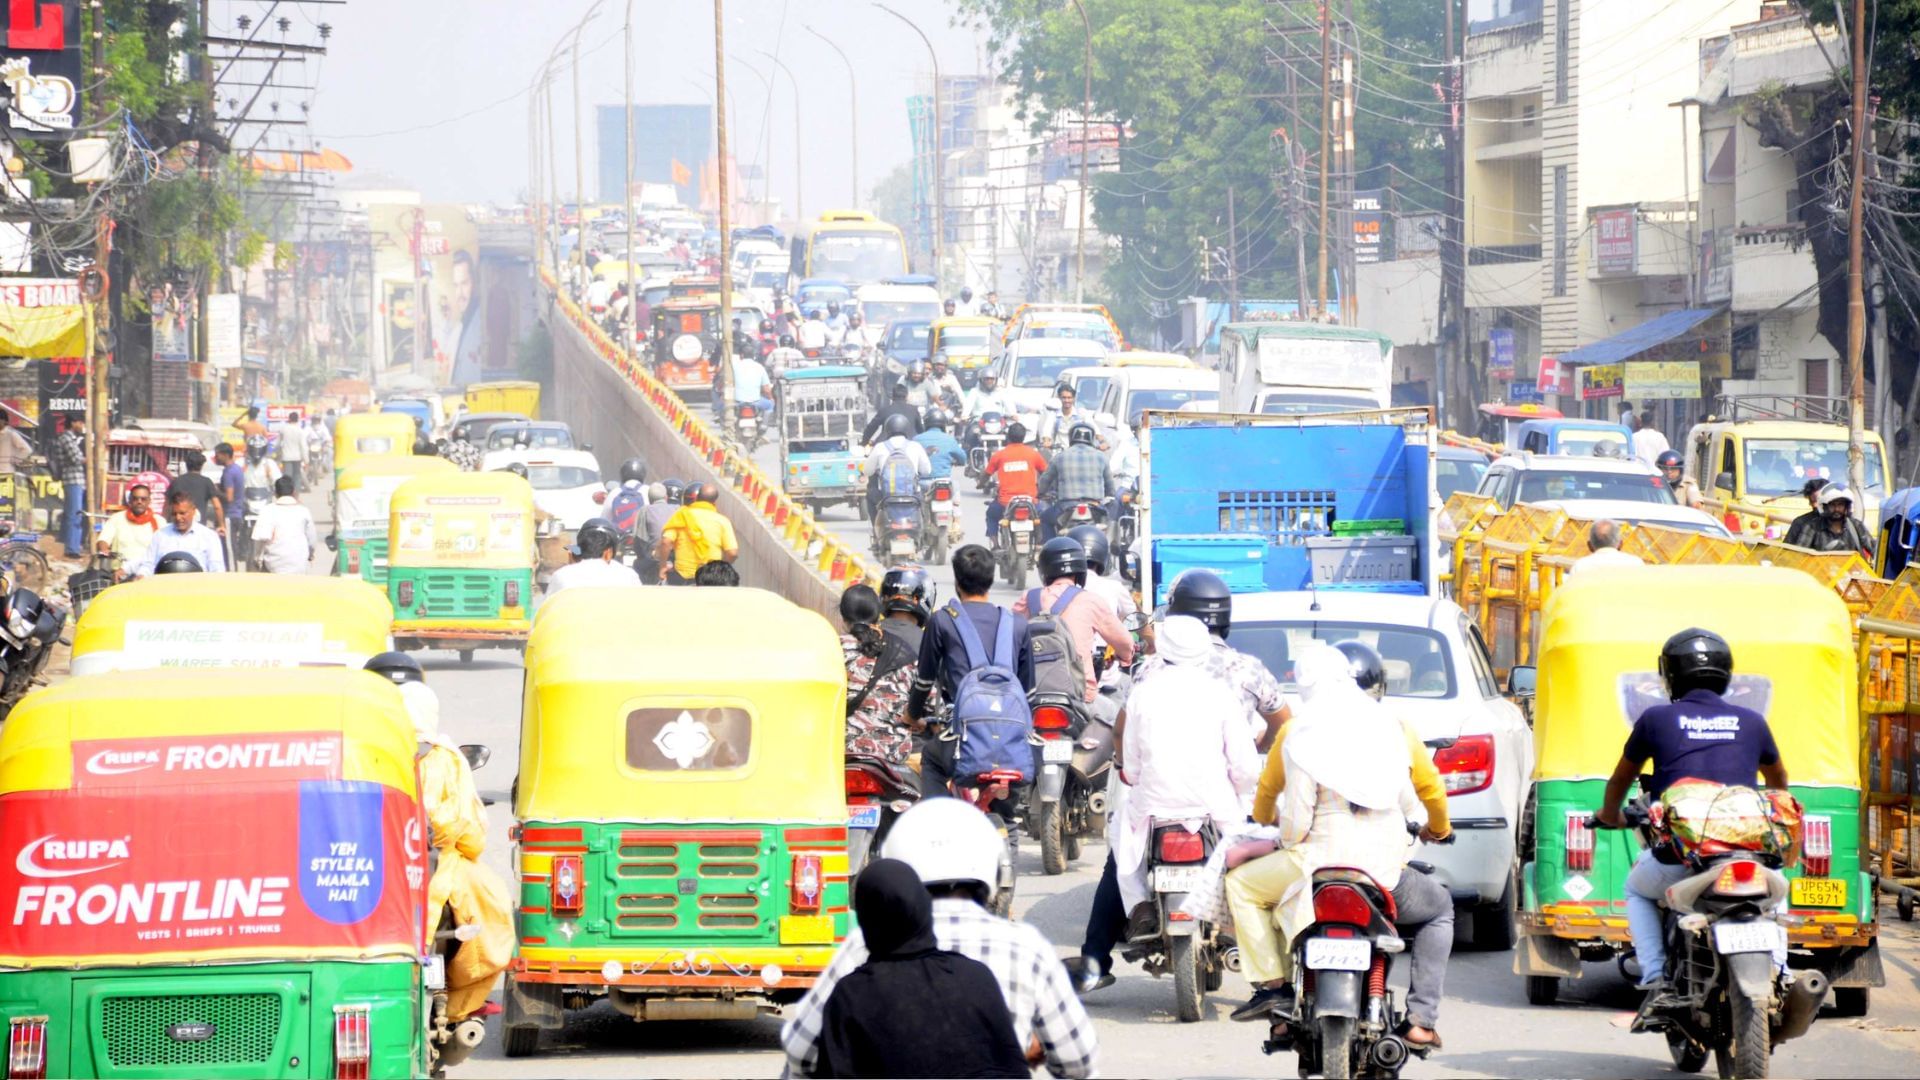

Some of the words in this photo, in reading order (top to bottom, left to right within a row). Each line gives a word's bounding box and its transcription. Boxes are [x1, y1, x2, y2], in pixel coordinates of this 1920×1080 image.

[1353, 198, 1381, 210] OTEL
[0, 286, 21, 307] S
[24, 285, 82, 308] BOAR
[49, 398, 113, 411] RESTAUT
[137, 629, 225, 643] WAAREE
[237, 630, 310, 644] SOLAR
[104, 749, 160, 765] RUPA
[164, 740, 336, 771] FRONTLINE
[44, 837, 131, 860] RUPA
[329, 842, 358, 857] YEH
[310, 857, 355, 872] STYLE
[355, 858, 375, 872] KA
[316, 874, 370, 888] MAMLA
[12, 876, 291, 926] FRONTLINE
[1801, 893, 1838, 905] T5971
[137, 929, 171, 941] VESTS
[186, 926, 223, 939] BRIEFS
[239, 923, 281, 936] TRUNKS
